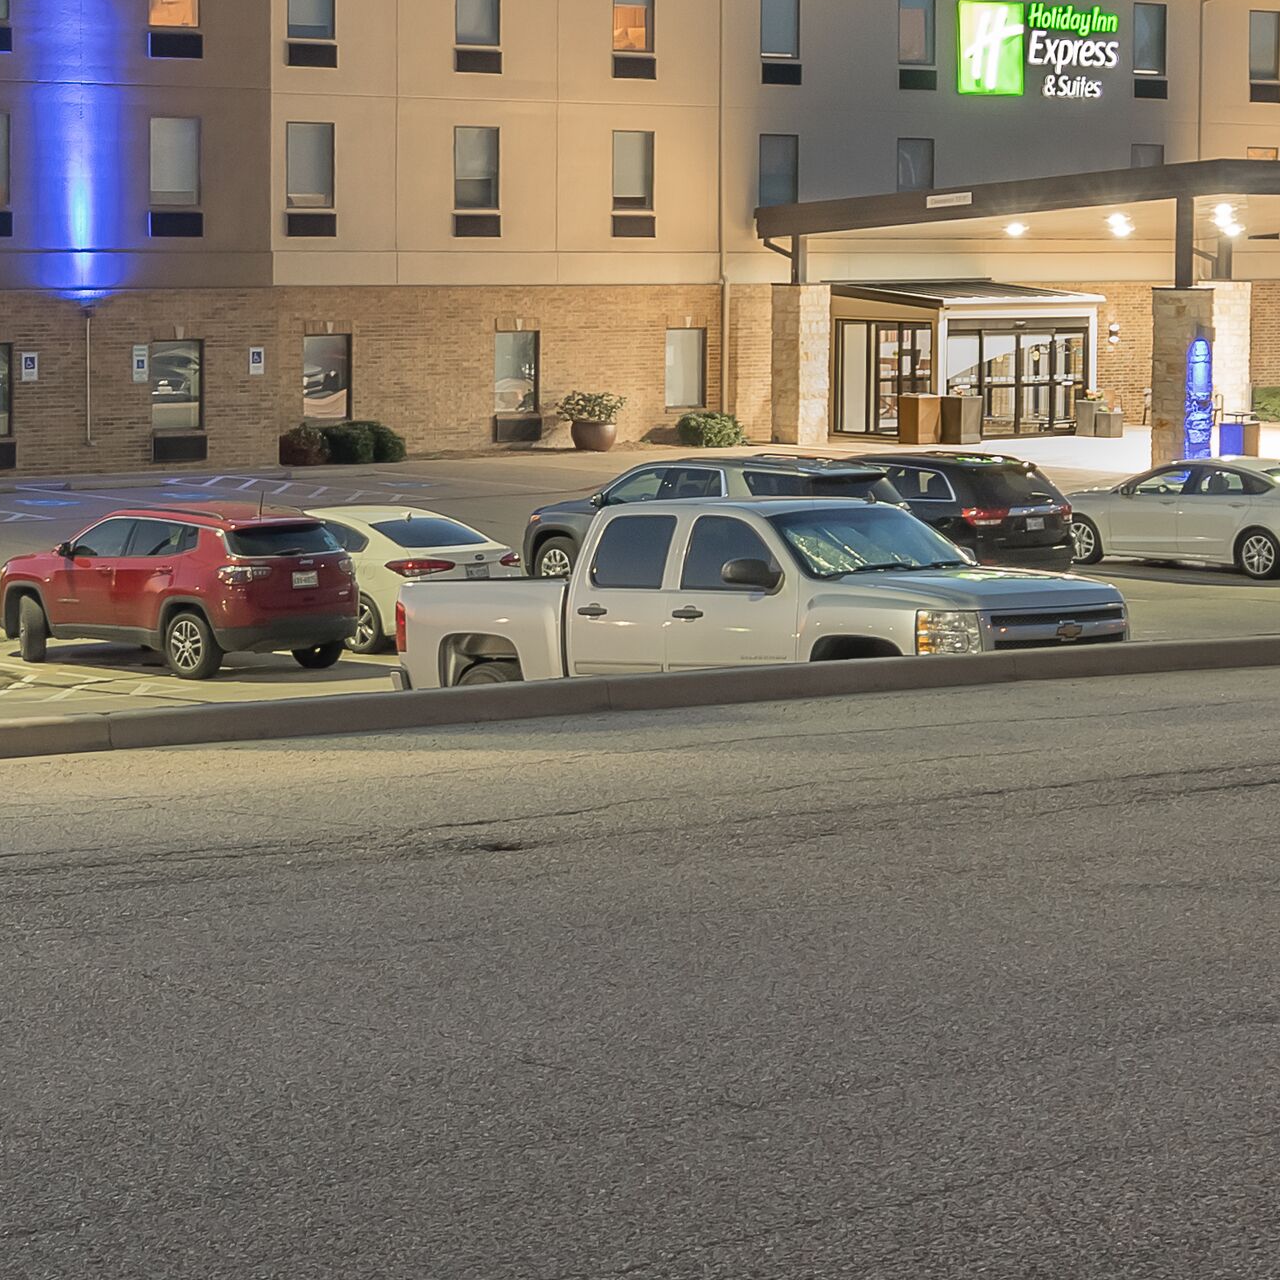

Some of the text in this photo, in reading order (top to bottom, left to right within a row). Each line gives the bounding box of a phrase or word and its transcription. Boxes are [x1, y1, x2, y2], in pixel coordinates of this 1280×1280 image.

[1027, 1, 1119, 38] Holiday Inn
[1027, 29, 1120, 75] Express
[1042, 74, 1103, 98] & Suites
